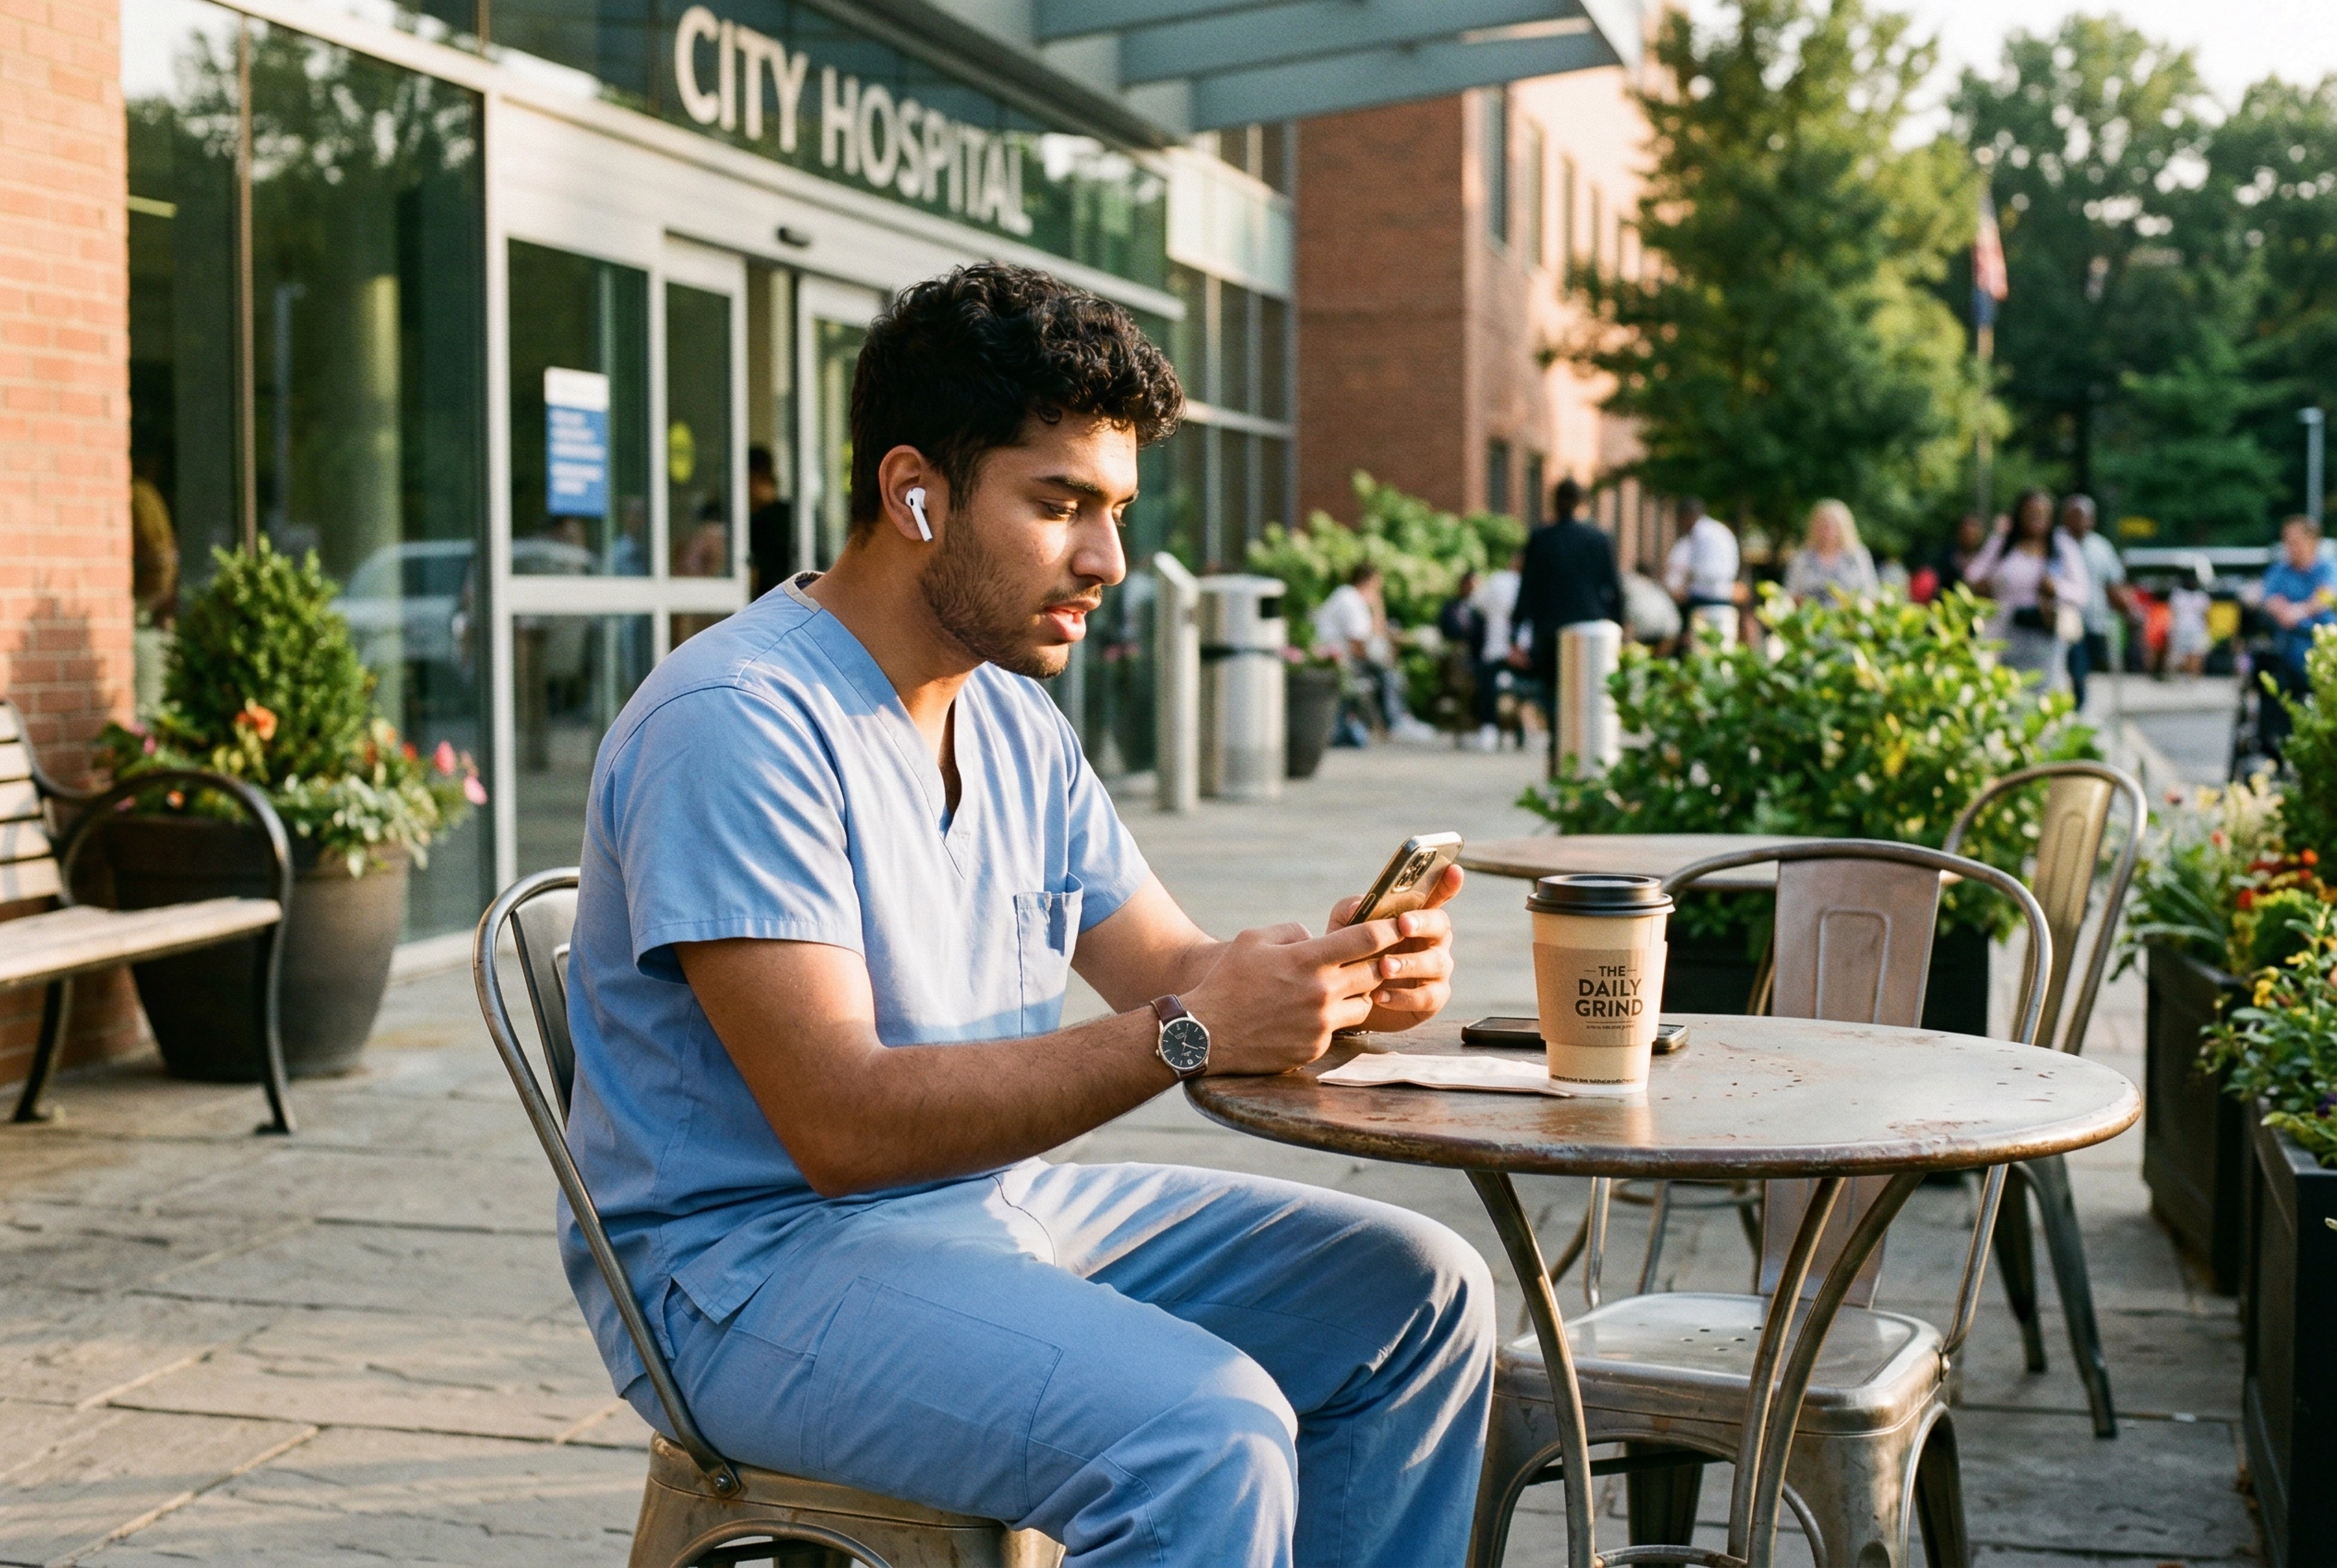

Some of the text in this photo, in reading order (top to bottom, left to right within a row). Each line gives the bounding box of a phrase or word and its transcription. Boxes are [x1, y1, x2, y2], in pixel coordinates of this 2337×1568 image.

[675, 5, 1033, 237] CITY HOSPITAL
[1598, 965, 1625, 976] THE
[1579, 978, 1642, 997] DAILY
[1574, 998, 1643, 1017] GRIND
